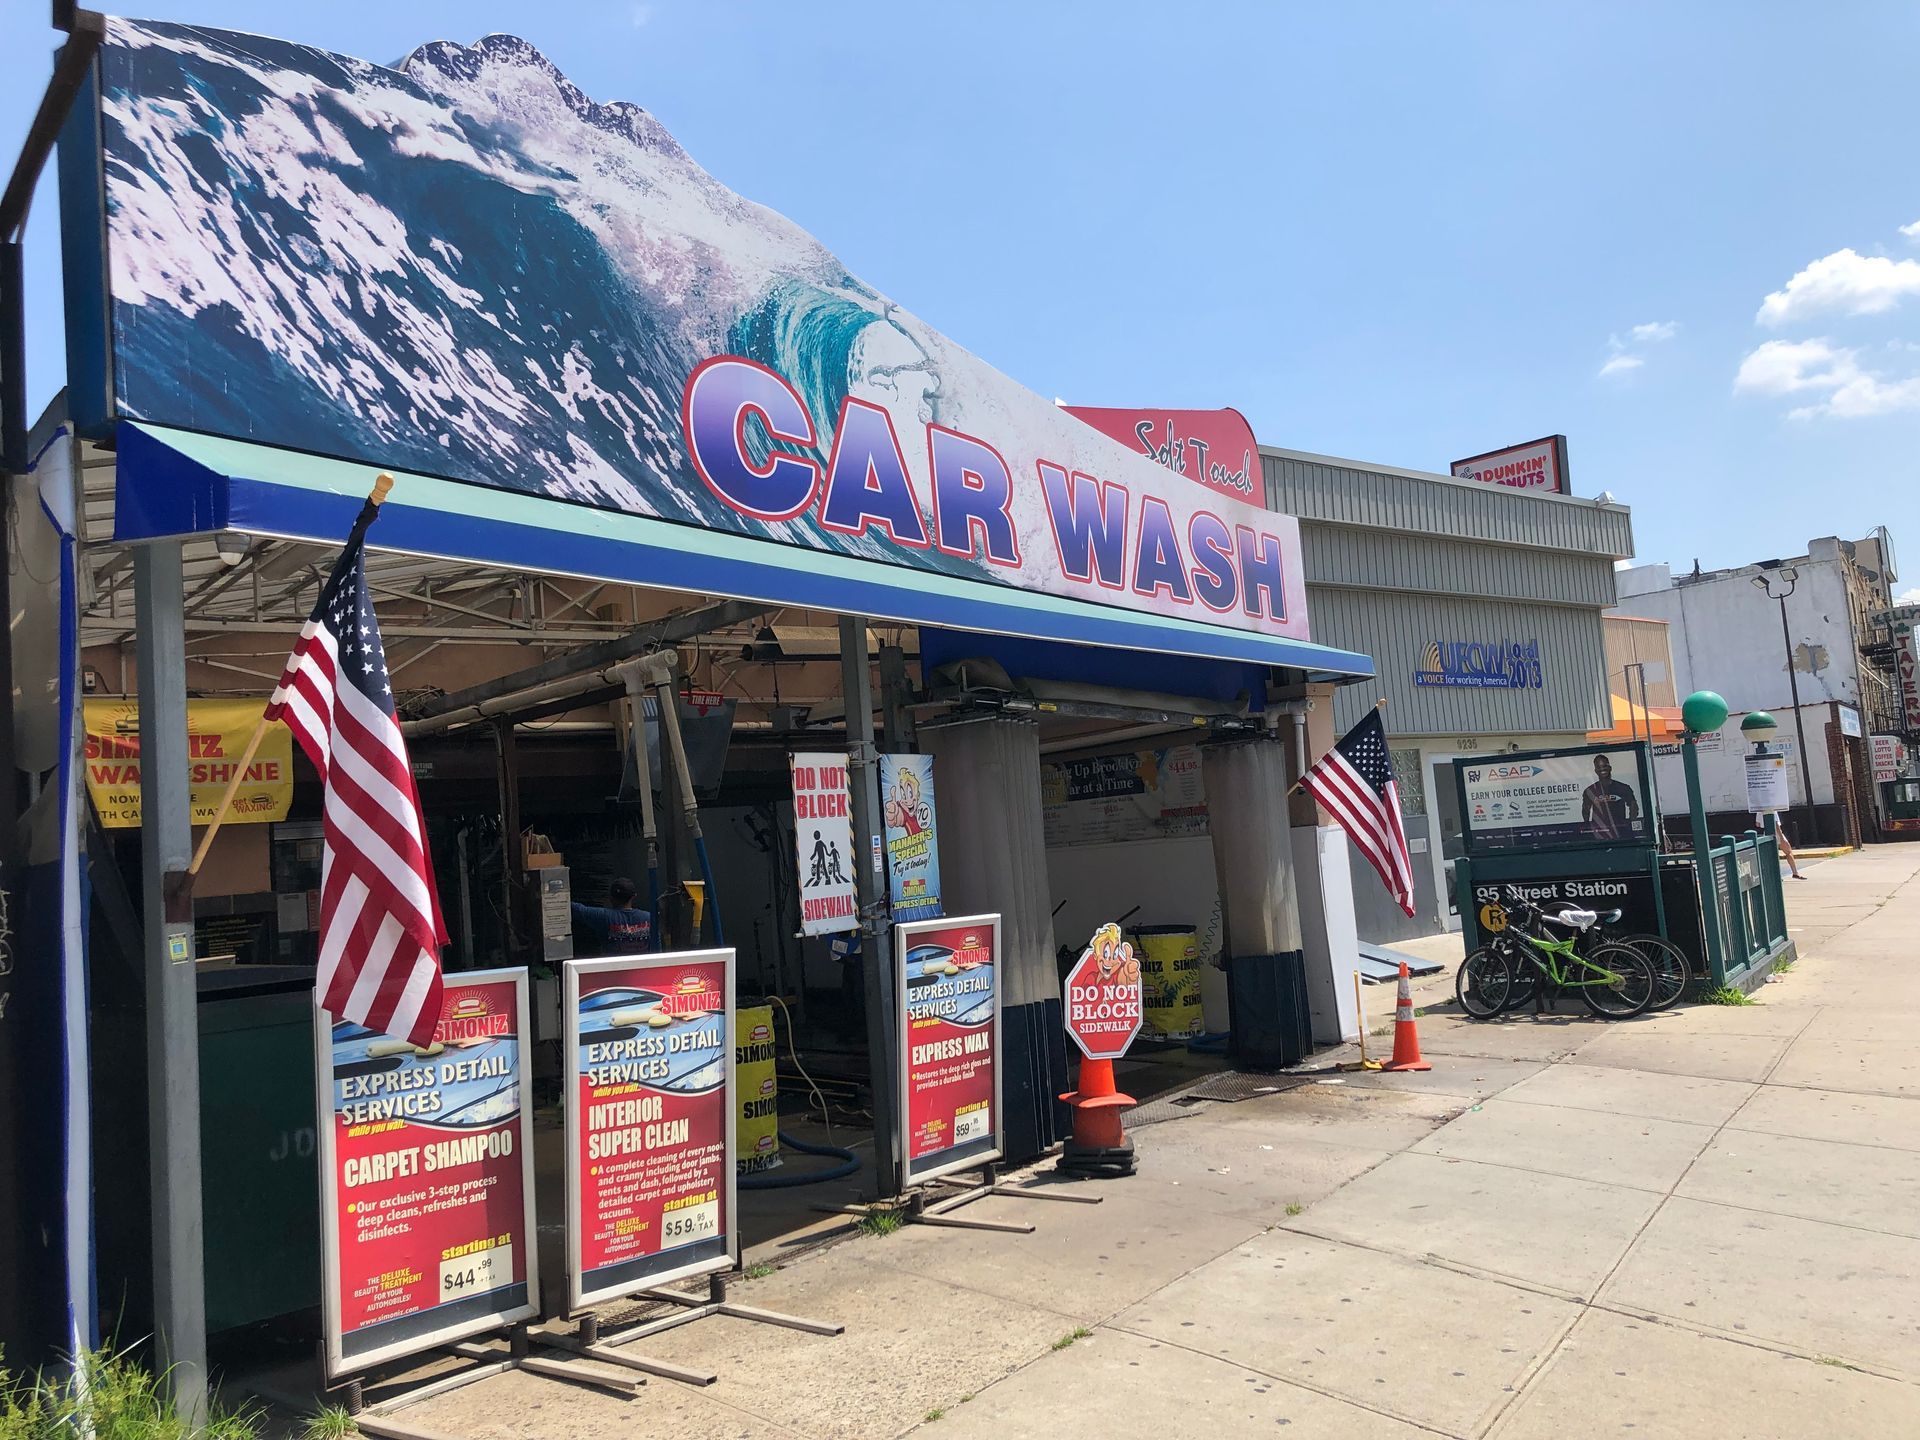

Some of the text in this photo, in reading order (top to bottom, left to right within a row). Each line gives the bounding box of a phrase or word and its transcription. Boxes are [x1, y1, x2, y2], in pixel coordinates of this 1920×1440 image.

[1135, 419, 1254, 495] Soft Touch
[1483, 455, 1547, 482] DUNKIN'
[683, 354, 1288, 625] CAR WASH
[1497, 470, 1545, 488] NUTS
[1437, 640, 1504, 673] UFCW
[1423, 675, 1444, 684] VOICE
[1446, 675, 1454, 684] for
[1457, 676, 1482, 686] working
[1483, 677, 1507, 685] America
[1506, 660, 1542, 688] 2013
[795, 767, 845, 790] DO NOT
[1105, 778, 1134, 791] Time
[1488, 765, 1531, 779] ASAP
[1876, 771, 1895, 780] ATM
[109, 795, 140, 804] NOW
[1471, 783, 1579, 800] EARN YOUR COLLEGE DEGREE!
[797, 794, 847, 819] BLOCK
[889, 828, 933, 853] MANAGER'S
[895, 843, 928, 862] SPECIAL
[893, 862, 904, 877] Try
[910, 852, 931, 870] today!
[1476, 886, 1500, 903] 95
[1565, 881, 1628, 898] Station
[805, 895, 853, 922] SIDEWALK
[953, 947, 989, 965] SIMONIZ
[910, 977, 989, 1003] EXPRESS DETAIL
[1072, 985, 1138, 1002] DO NOT
[662, 991, 720, 1015] SIMONIZ
[910, 999, 957, 1020] SERVICES
[1072, 1002, 1138, 1020] BLOCK
[433, 1013, 508, 1042] SIMONIZ
[1080, 1021, 1131, 1033] SIDEWALK
[588, 1029, 721, 1063] EXPRESS DETAIL
[912, 1032, 989, 1066] EXPRESS WAX
[342, 1056, 510, 1098] EXPRESS DETAIL
[588, 1058, 669, 1087] SERVICES
[916, 1070, 938, 1080] Restores
[939, 1067, 947, 1075] the
[949, 1065, 960, 1075] deep
[342, 1091, 441, 1125] SERVICES
[588, 1096, 662, 1131] INTERIOR
[955, 1099, 988, 1116] starting at
[588, 1118, 688, 1160] SUPER CLEAN
[344, 1130, 512, 1188] CARPET SHAMPOO
[598, 1141, 724, 1175] A complete cleaning of every nook
[598, 1154, 722, 1186] and cranny including door jambs,
[357, 1176, 497, 1213] Our exclusive 3-step process
[598, 1187, 621, 1197] vents
[623, 1182, 639, 1193] and
[641, 1178, 661, 1189] dash,
[662, 1172, 692, 1185] followed
[694, 1167, 702, 1177] by
[598, 1177, 715, 1209] detailed carpet and upholstery
[358, 1189, 487, 1228] deep cleans, refreshes and
[664, 1189, 717, 1212] starting at
[598, 1208, 633, 1220] vacuum.
[616, 1217, 640, 1227] DELUXE
[358, 1223, 412, 1242] disinfects.
[594, 1222, 649, 1240] BEAUTY TREATMENT
[441, 1233, 511, 1261] starting at
[354, 1272, 422, 1297] BEAUTY TREATMENT
[368, 1267, 410, 1286] THE DELUXE
[367, 1294, 411, 1312] AUTOMOBILES!
[374, 1288, 403, 1301] FOR YOUR
